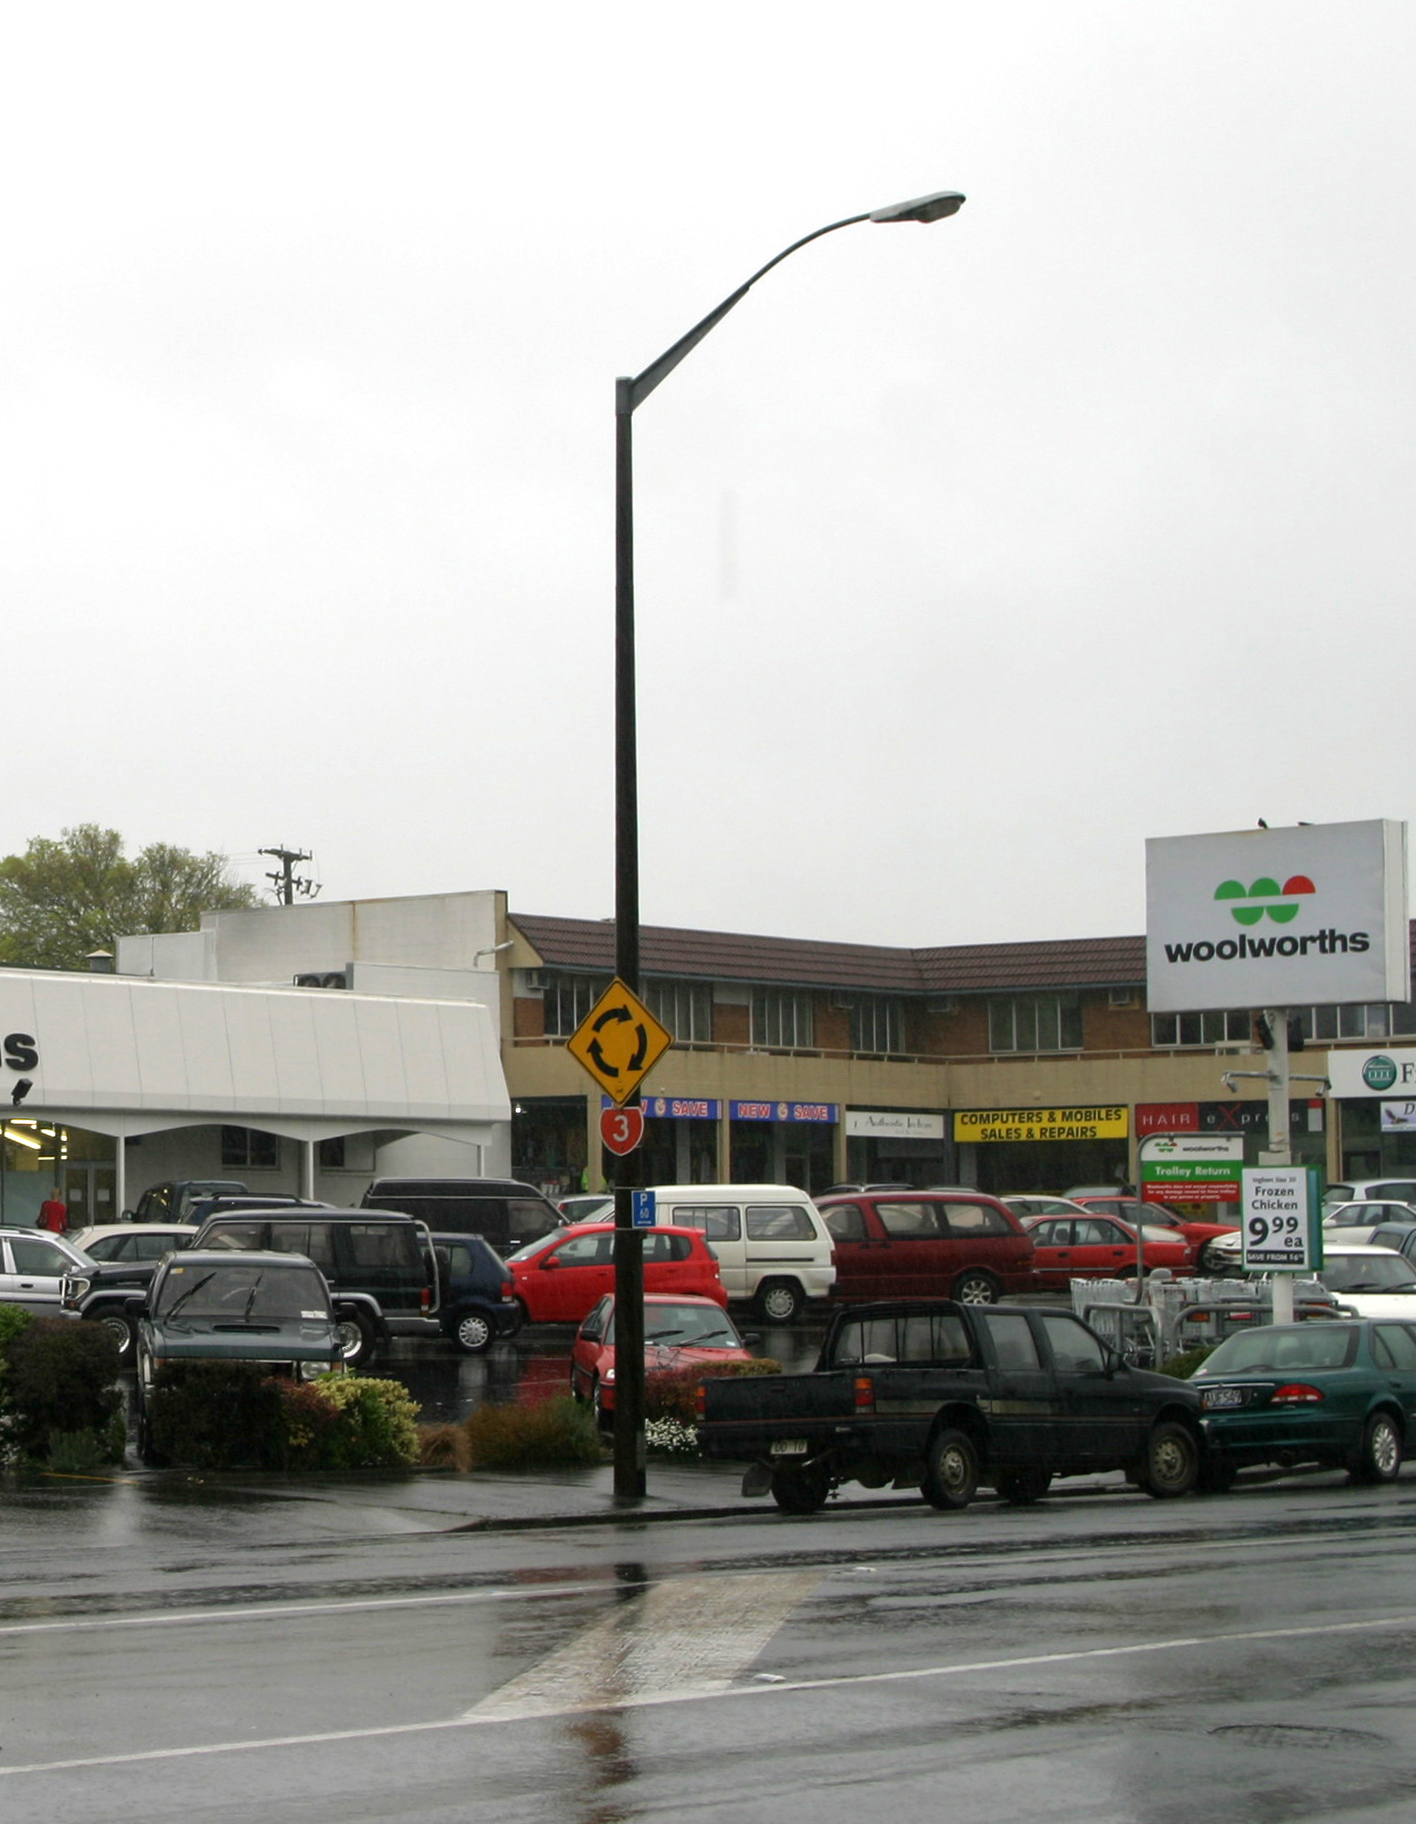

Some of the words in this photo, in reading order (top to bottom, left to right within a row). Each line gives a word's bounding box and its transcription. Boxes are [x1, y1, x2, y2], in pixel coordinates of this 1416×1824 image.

[1164, 929, 1370, 963] woolworths
[672, 1100, 708, 1116] SAVE
[737, 1103, 770, 1119] NEW
[794, 1104, 828, 1120] SAVE
[960, 1110, 1043, 1126] COMPUTERS
[1047, 1110, 1058, 1123] &
[1061, 1108, 1122, 1122] MOBILES
[1142, 1113, 1190, 1126] HAIR
[1207, 1104, 1299, 1129] eXprs
[612, 1114, 630, 1142] 3
[980, 1127, 1021, 1140] SALES
[1024, 1127, 1034, 1139] &
[1039, 1126, 1097, 1139] REPAIRS
[1155, 1166, 1191, 1177] Trolley
[1195, 1166, 1231, 1175] Return
[1255, 1186, 1295, 1196] Frozen
[640, 1193, 648, 1206] P
[1251, 1200, 1298, 1210] Chicken
[1284, 1236, 1303, 1248] ea
[1247, 1253, 1265, 1261] SAVE
[1266, 1253, 1287, 1261] FROM
